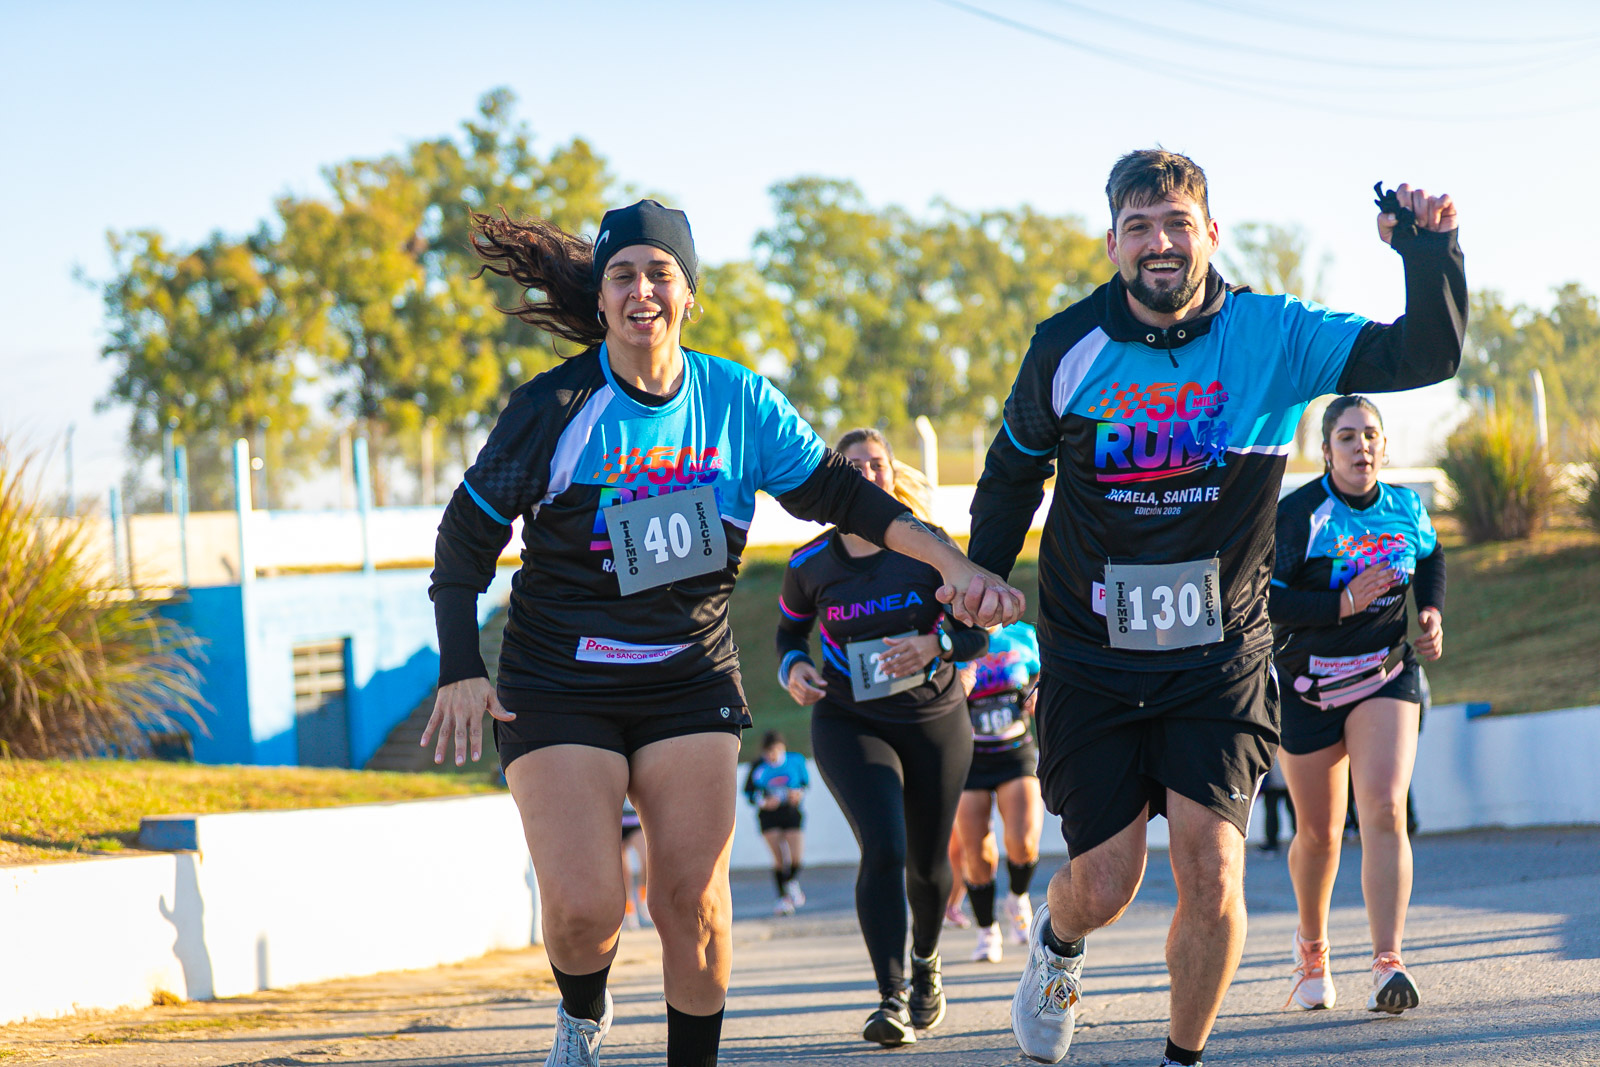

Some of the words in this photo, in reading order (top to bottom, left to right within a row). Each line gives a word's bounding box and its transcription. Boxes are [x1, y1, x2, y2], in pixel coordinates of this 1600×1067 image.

[1095, 421, 1212, 469] RUN
[1134, 506, 1162, 516] EDICIÓN
[1162, 506, 1181, 516] 2026
[1162, 488, 1204, 504] SANTA
[1204, 486, 1220, 502] FE
[620, 520, 639, 576] TIEMPO
[643, 512, 692, 564] 40
[694, 501, 713, 557] EXACTO
[827, 591, 923, 622] RUNNEA
[1115, 581, 1129, 634] TIEMPO
[1129, 582, 1201, 631] 130
[1203, 573, 1216, 627] EXACTO
